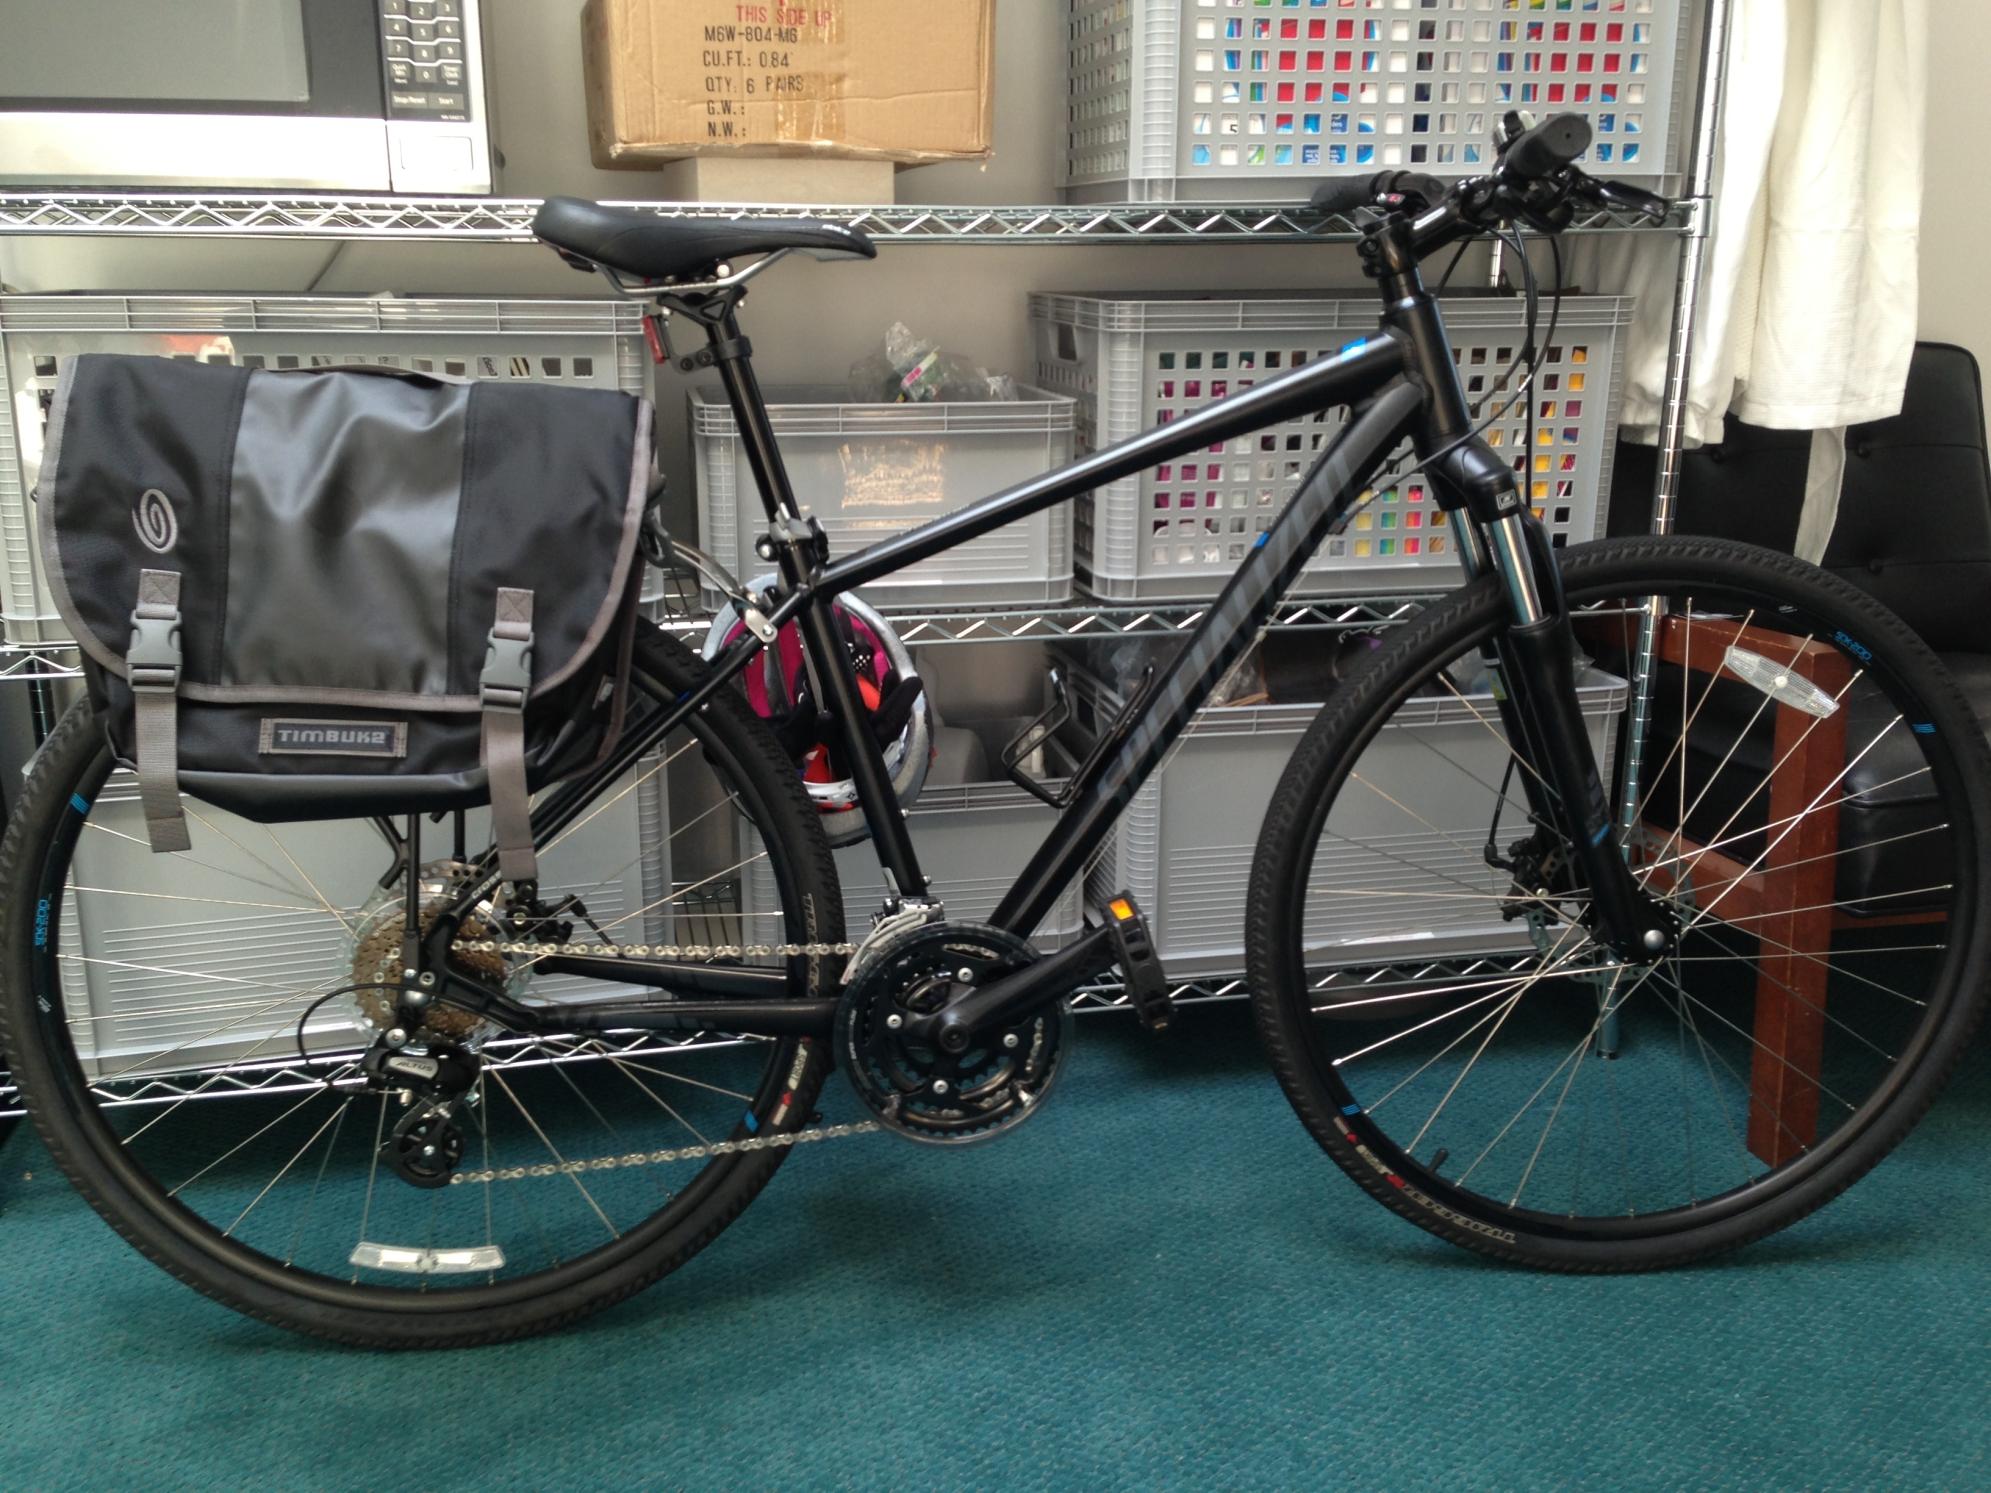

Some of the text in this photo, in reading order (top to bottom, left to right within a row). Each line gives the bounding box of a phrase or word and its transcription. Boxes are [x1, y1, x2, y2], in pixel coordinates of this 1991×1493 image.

[736, 4, 832, 28] THIS SIDE UP
[423, 70, 430, 79] 0
[746, 78, 755, 94] 6
[765, 75, 804, 93] PAIRS
[277, 729, 386, 744] TIMBUK2
[396, 1061, 433, 1072] ALTUS
